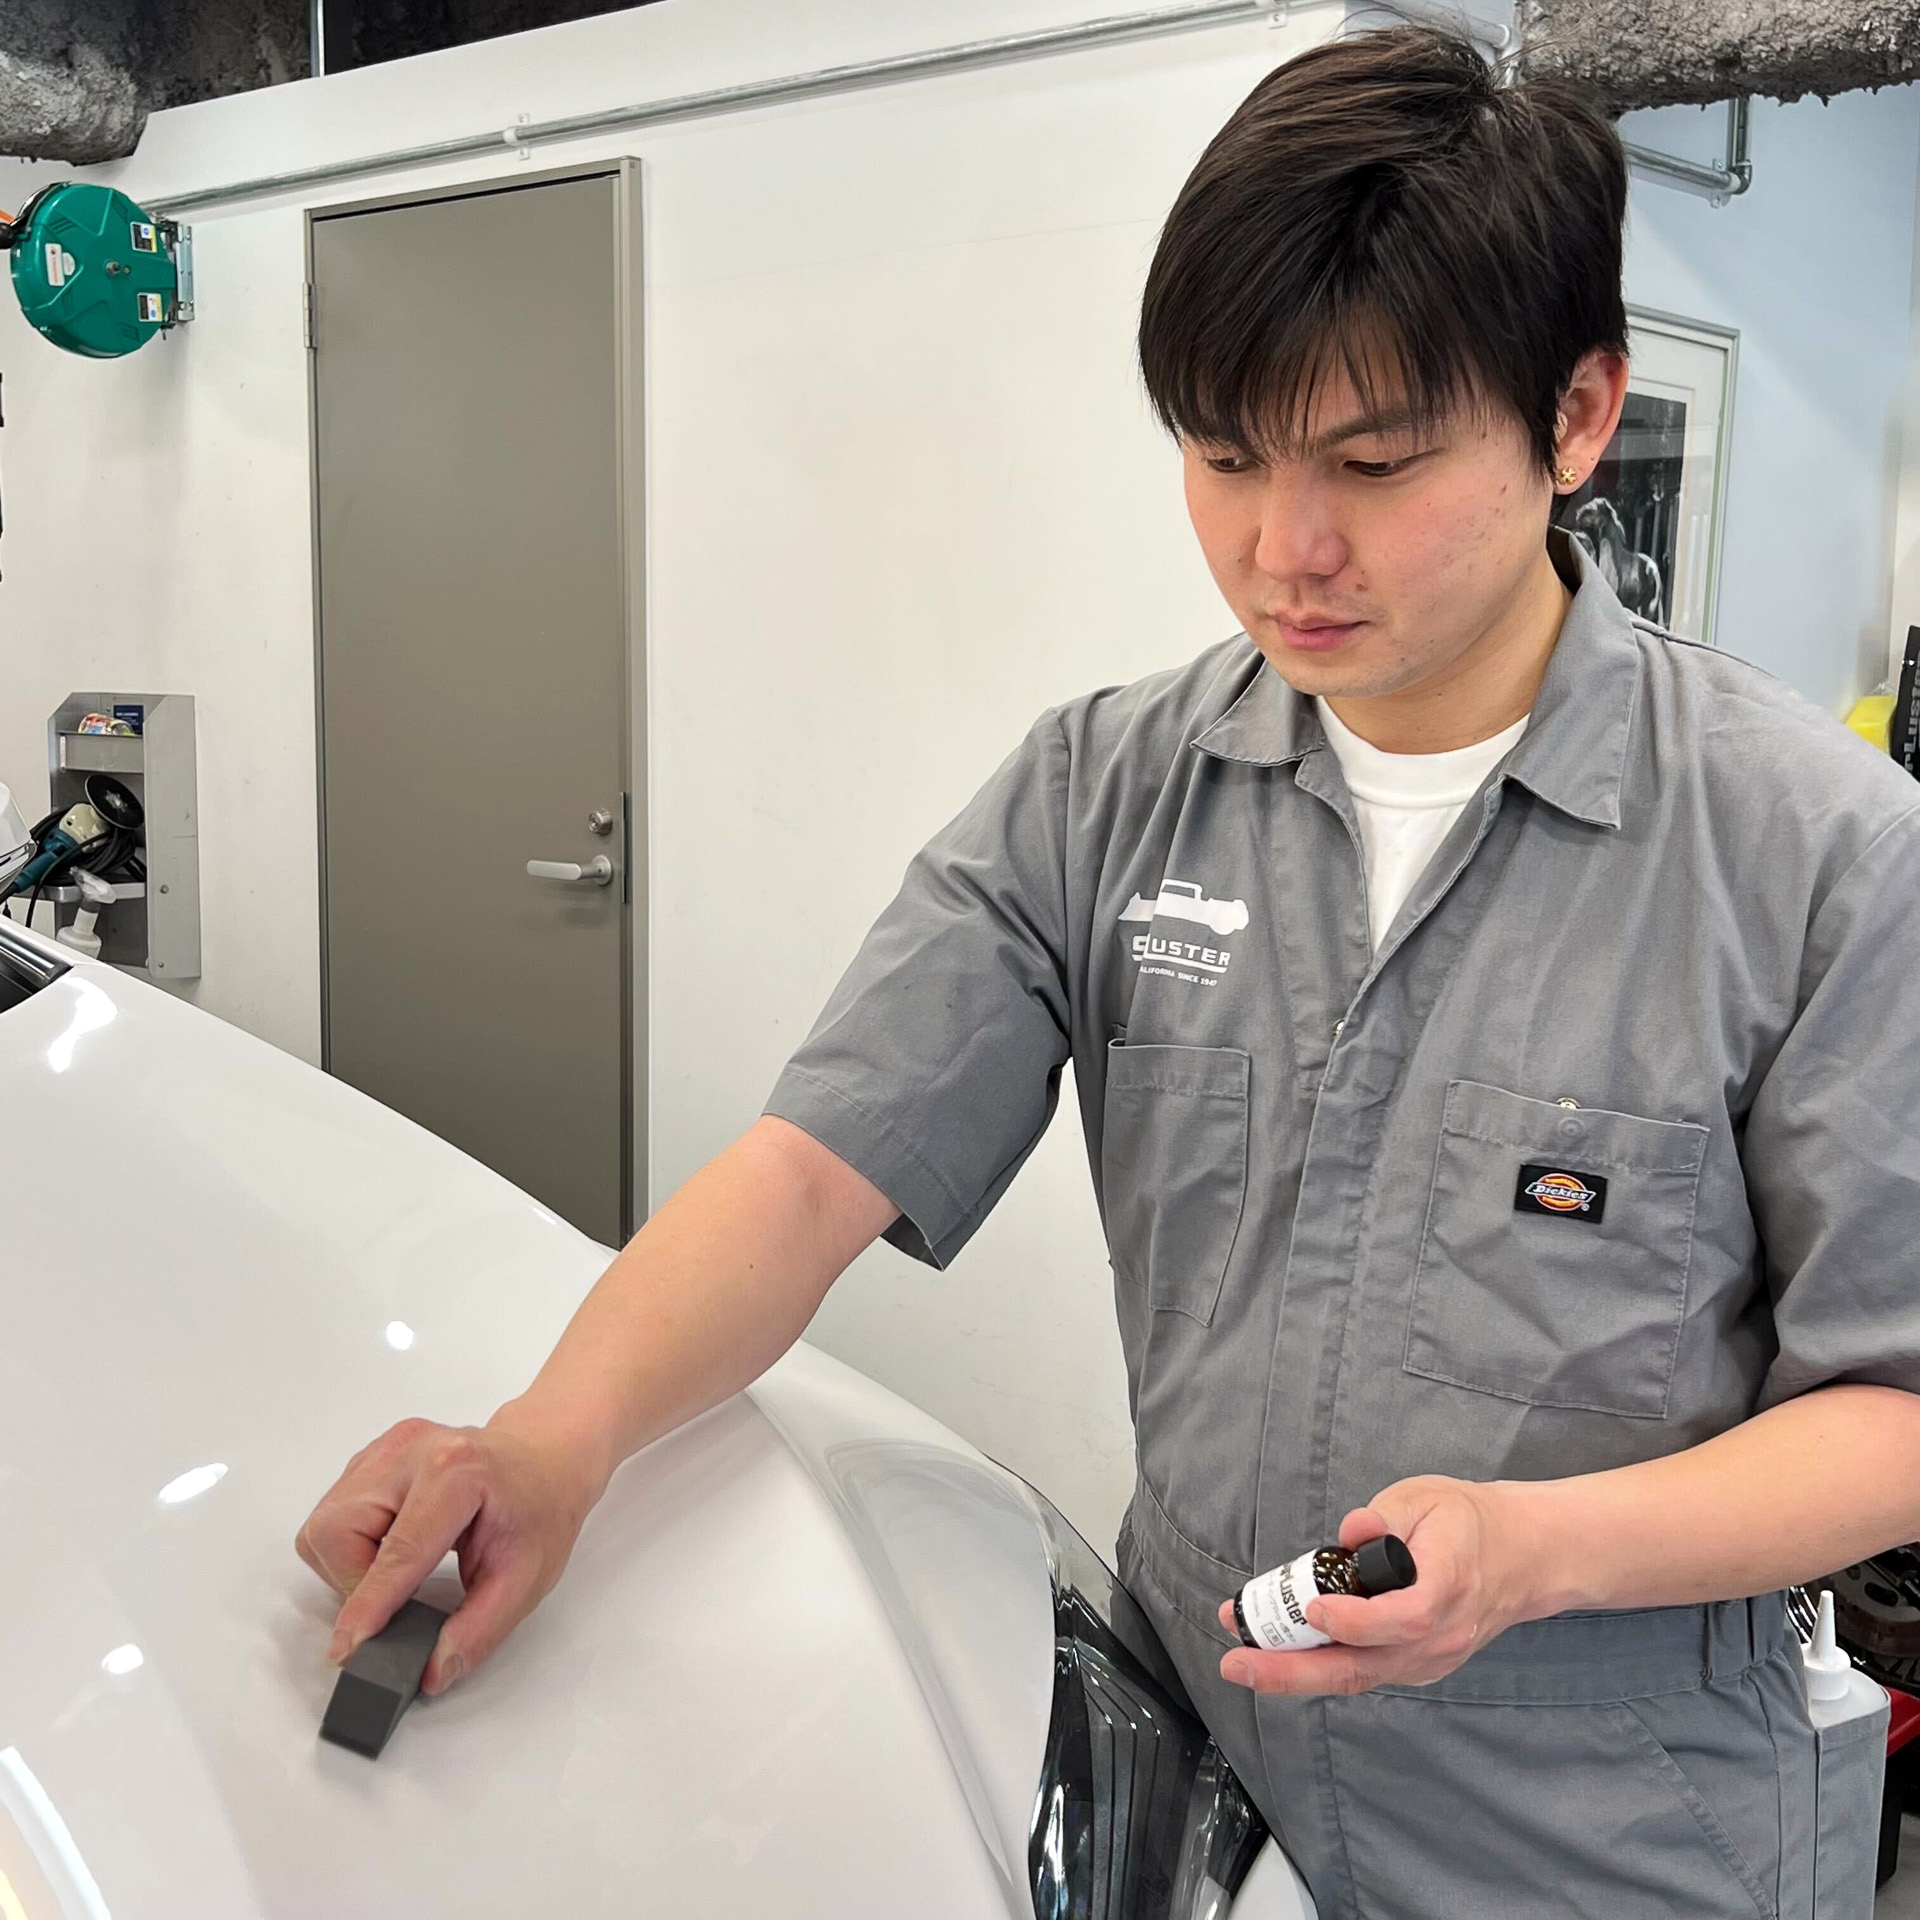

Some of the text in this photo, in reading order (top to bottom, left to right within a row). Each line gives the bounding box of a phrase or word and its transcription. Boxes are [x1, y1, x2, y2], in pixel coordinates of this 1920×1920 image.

[1139, 966, 1175, 977] ALIFORNIA
[1177, 972, 1199, 983] SINCE
[1533, 1185, 1589, 1200] Dickies
